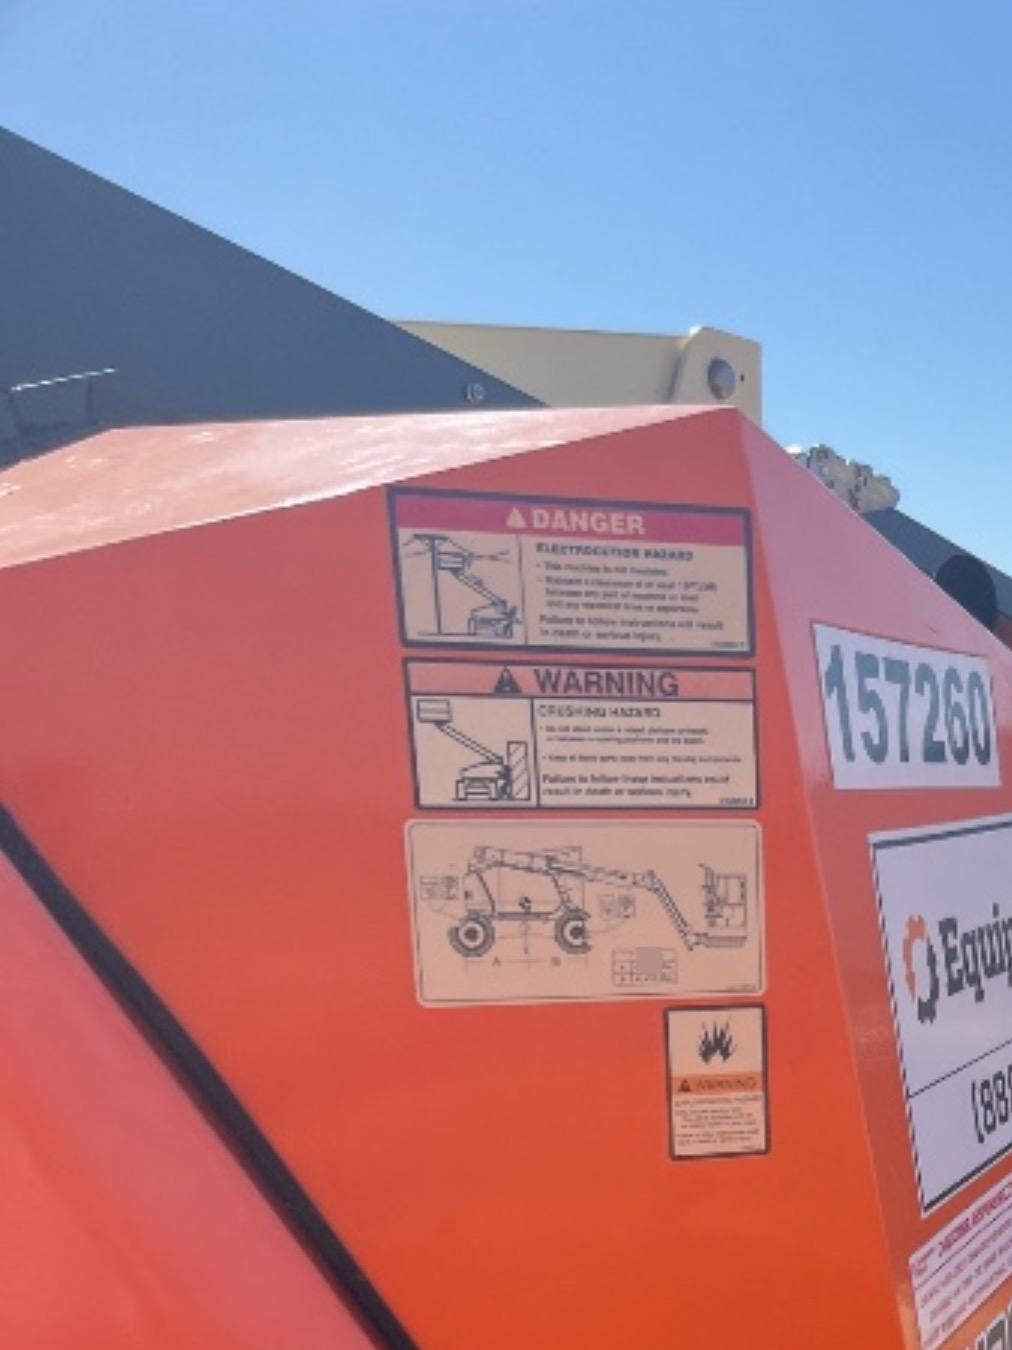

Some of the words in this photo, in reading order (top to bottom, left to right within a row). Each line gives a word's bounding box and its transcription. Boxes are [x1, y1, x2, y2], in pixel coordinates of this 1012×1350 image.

[532, 508, 646, 535] DANGER
[534, 668, 679, 697] WARNING
[825, 644, 992, 765] 157260
